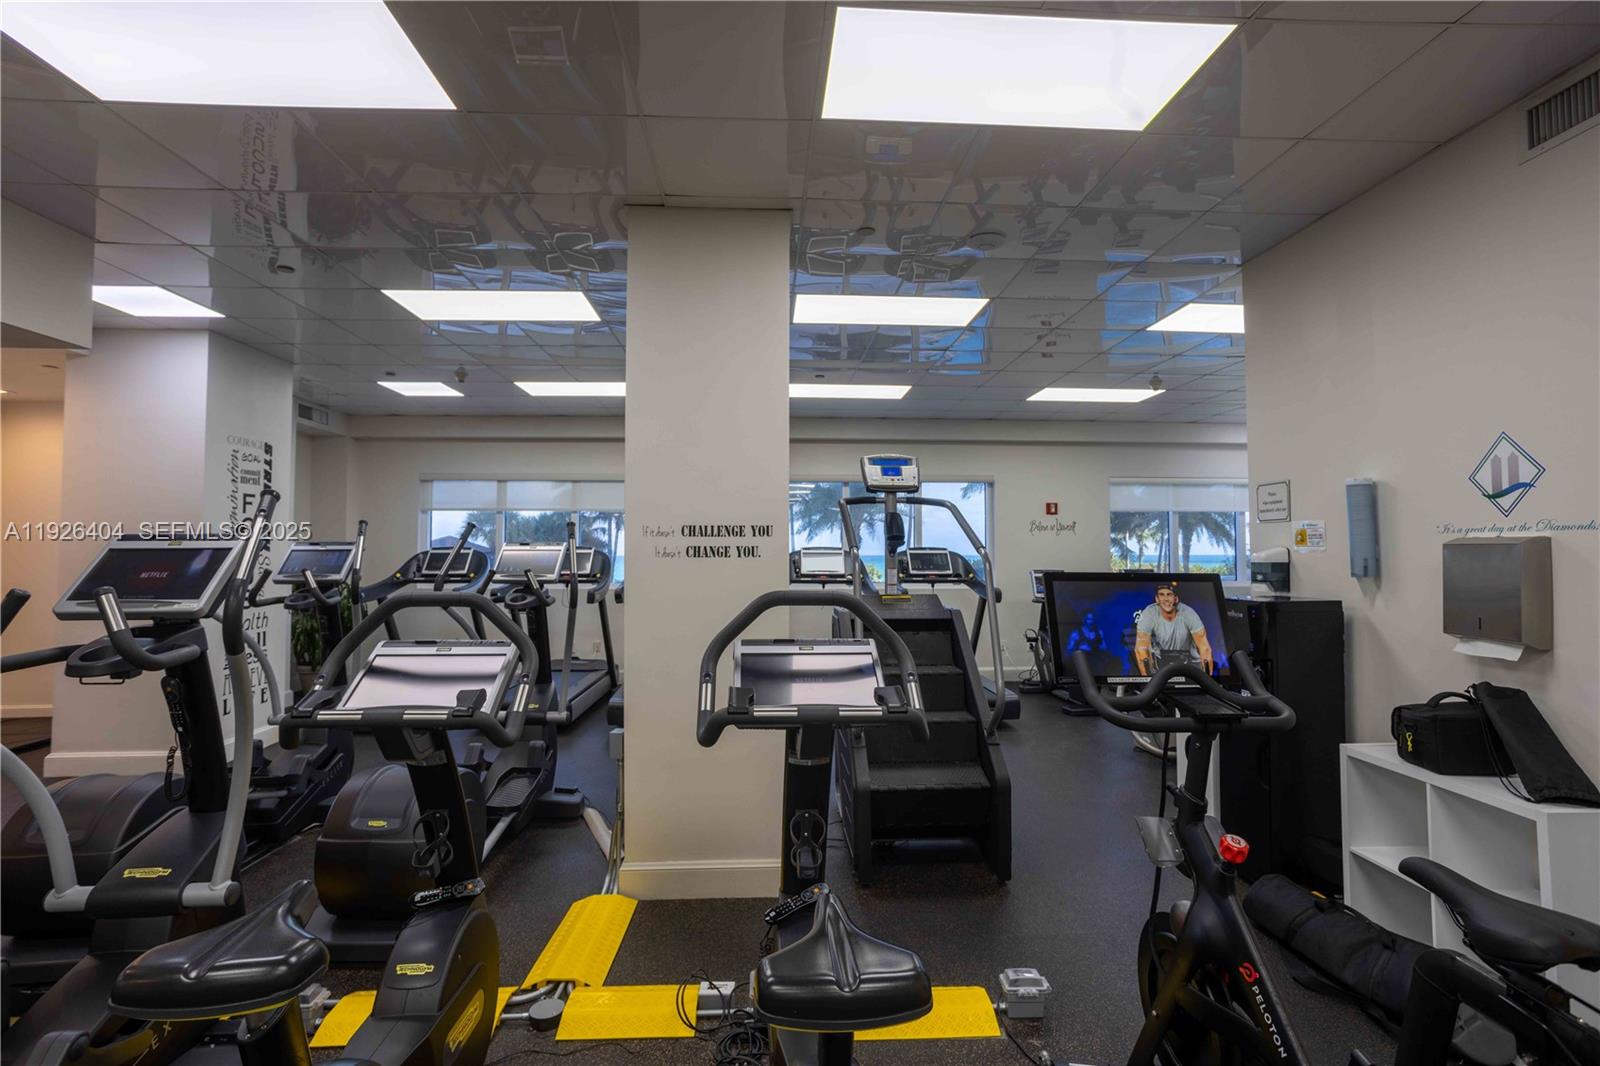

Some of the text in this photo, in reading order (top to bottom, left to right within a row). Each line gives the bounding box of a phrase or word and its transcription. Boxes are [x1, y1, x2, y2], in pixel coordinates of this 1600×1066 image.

[681, 525, 746, 537] CHALLENGE
[750, 525, 773, 537] YOU
[1463, 526, 1487, 537] great
[1488, 523, 1504, 536] day
[1506, 524, 1517, 533] at
[1518, 522, 1533, 533] the
[686, 546, 731, 558] CHANGE
[736, 546, 761, 558] YOU.
[1252, 985, 1288, 1058] PELOTON
